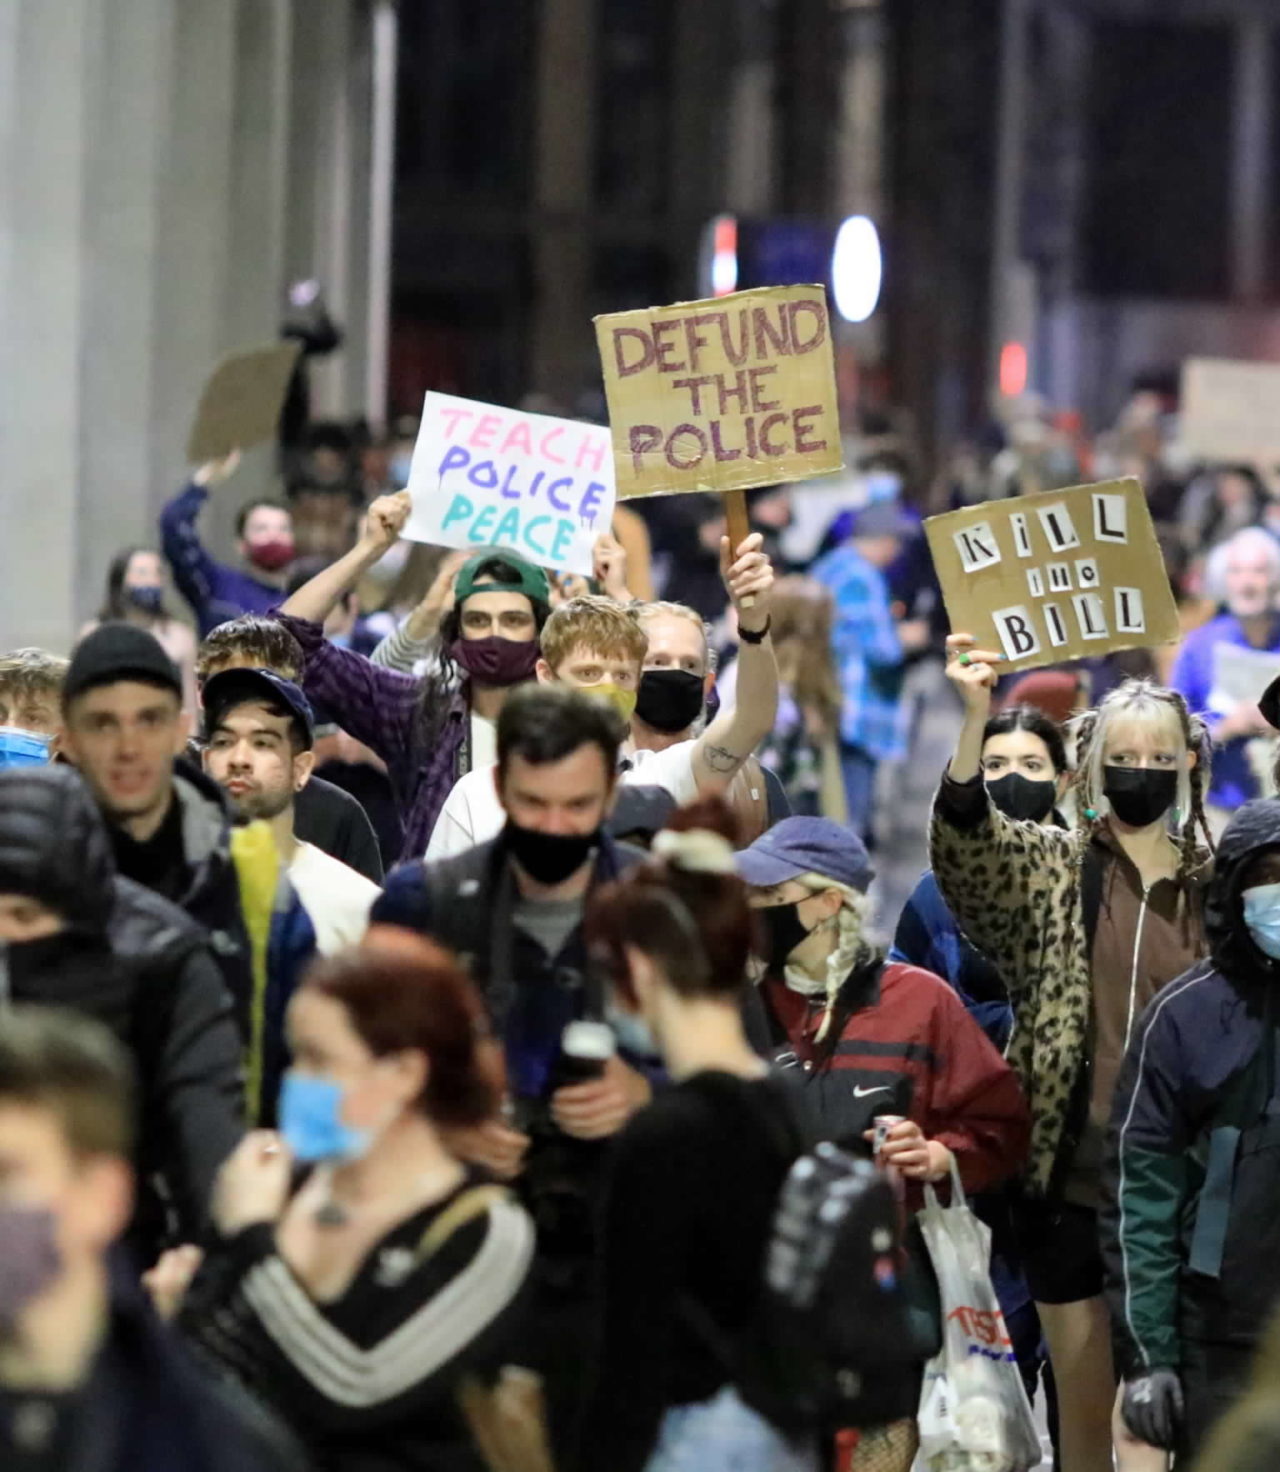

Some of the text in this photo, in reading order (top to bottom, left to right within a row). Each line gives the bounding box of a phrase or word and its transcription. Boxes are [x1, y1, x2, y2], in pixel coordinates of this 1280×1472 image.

[611, 299, 827, 378] DEFUND
[672, 365, 781, 417] THE
[439, 408, 608, 472] TEACH
[627, 404, 828, 477] POLICE
[438, 445, 607, 530] POLICE
[441, 494, 577, 562] PEACE
[1003, 591, 1143, 656] BILL
